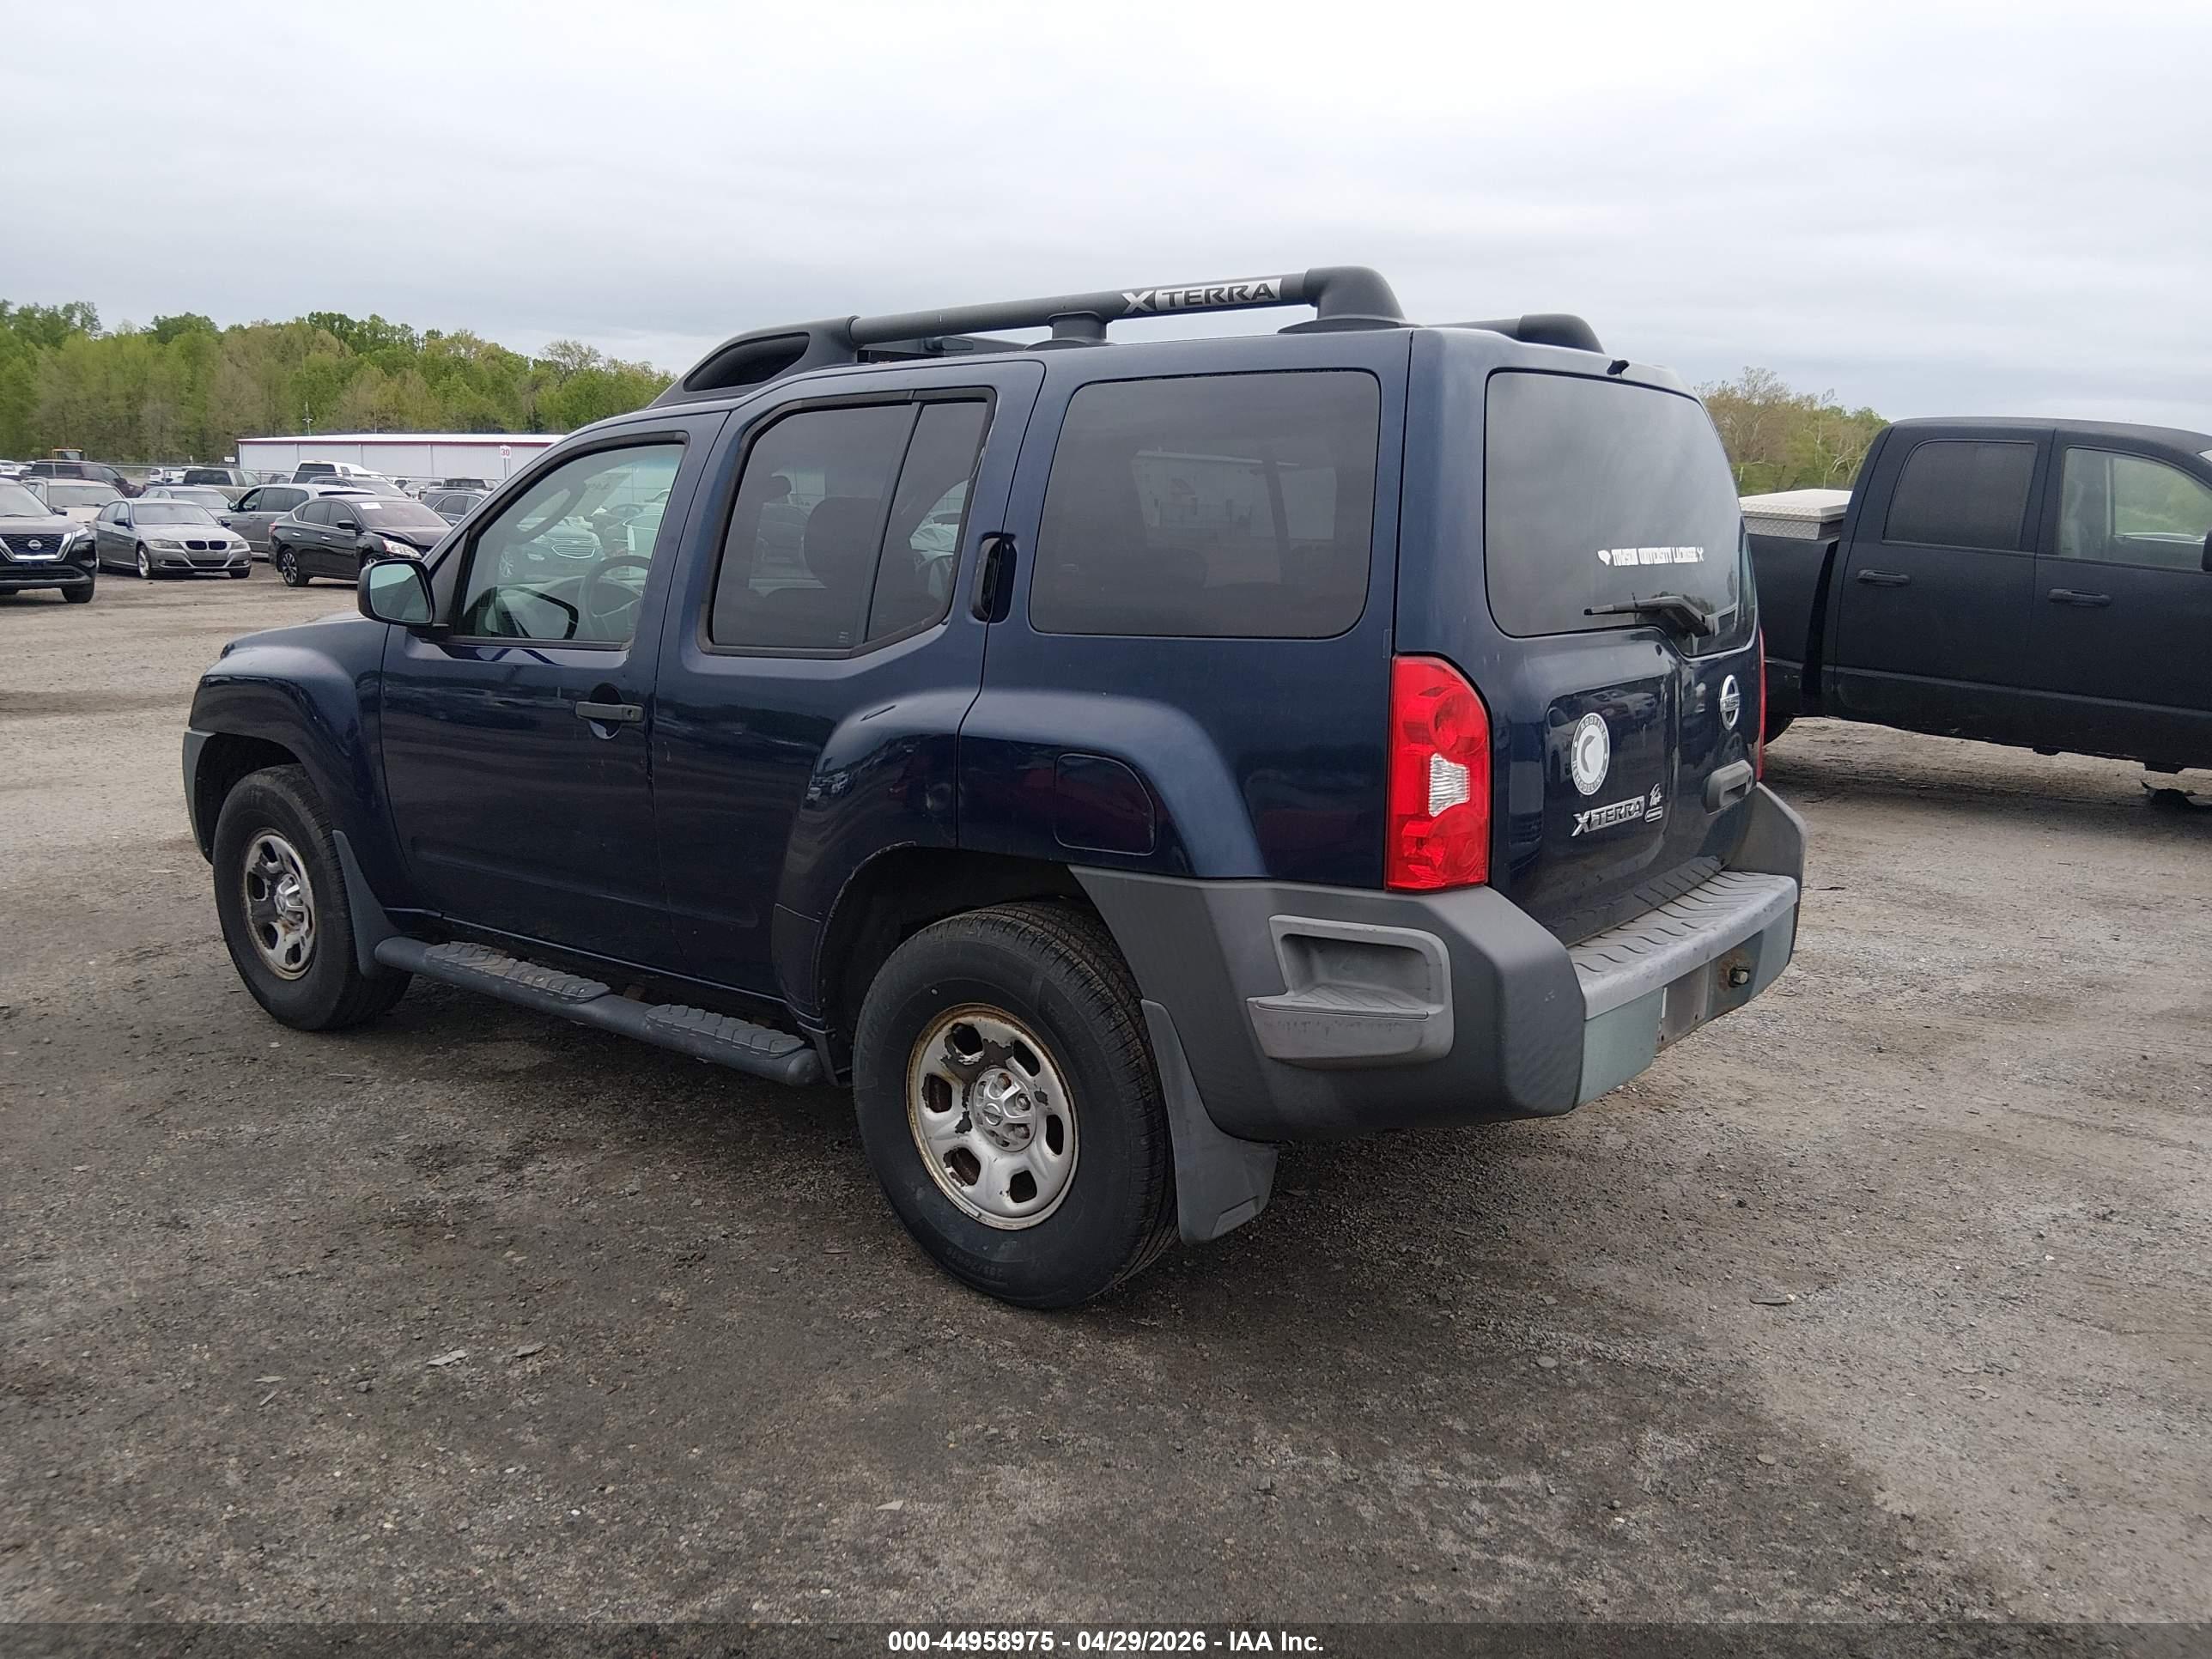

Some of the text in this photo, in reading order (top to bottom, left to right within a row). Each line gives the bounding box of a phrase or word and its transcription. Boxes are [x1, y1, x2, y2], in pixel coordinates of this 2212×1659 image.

[1121, 283, 1276, 314] XTERRA
[1572, 760, 1604, 792] REMODELING
[1571, 795, 1644, 837] XTERRA
